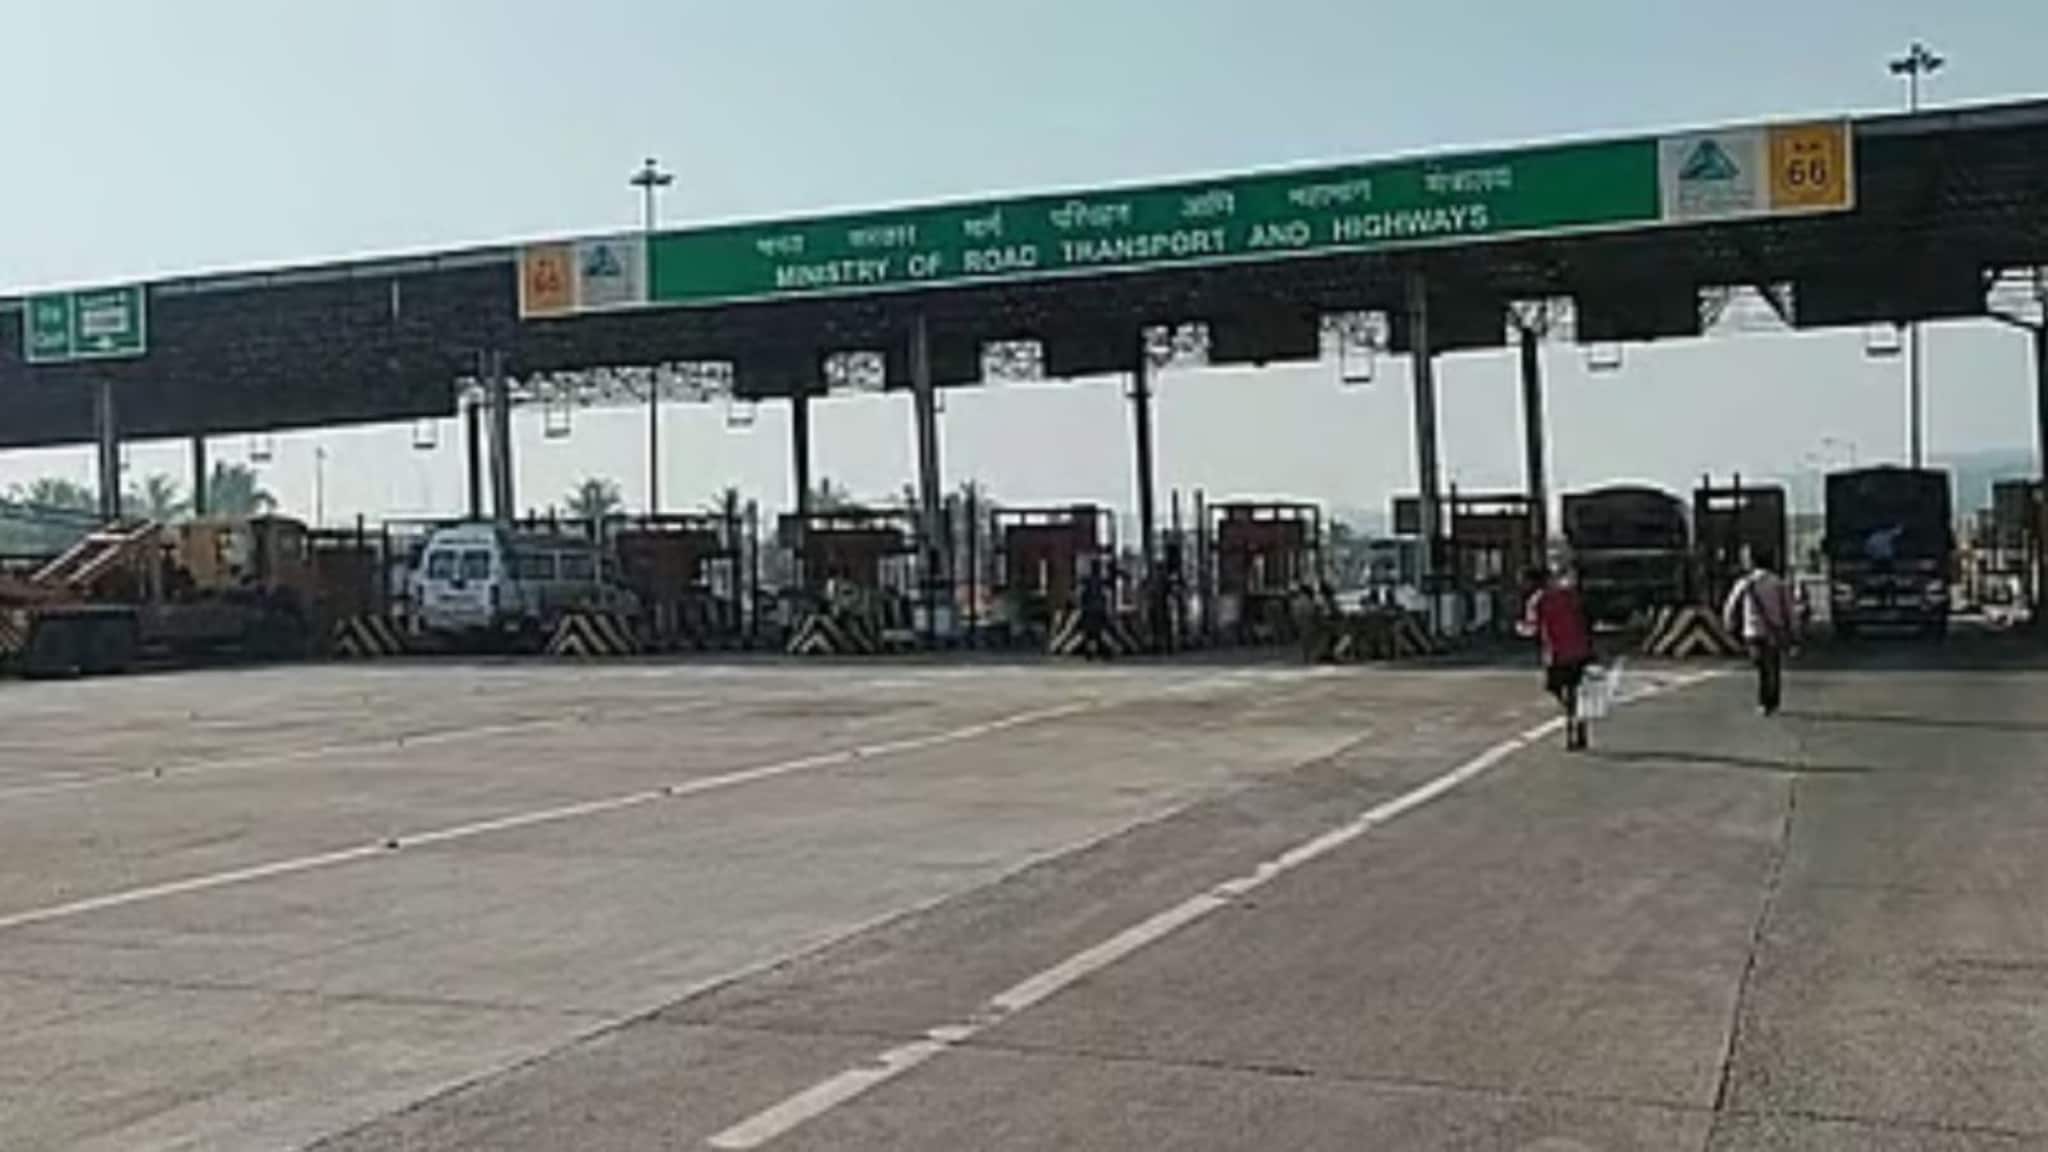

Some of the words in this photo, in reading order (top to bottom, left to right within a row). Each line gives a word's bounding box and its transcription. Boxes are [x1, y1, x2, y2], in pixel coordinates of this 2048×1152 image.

[776, 258, 889, 288] MINISTRY
[908, 250, 940, 277] OF
[963, 245, 1038, 272] ROAD
[1062, 227, 1225, 262] TRANSPORT
[1248, 219, 1310, 247] AND
[1333, 203, 1489, 242] HIGHWAYS
